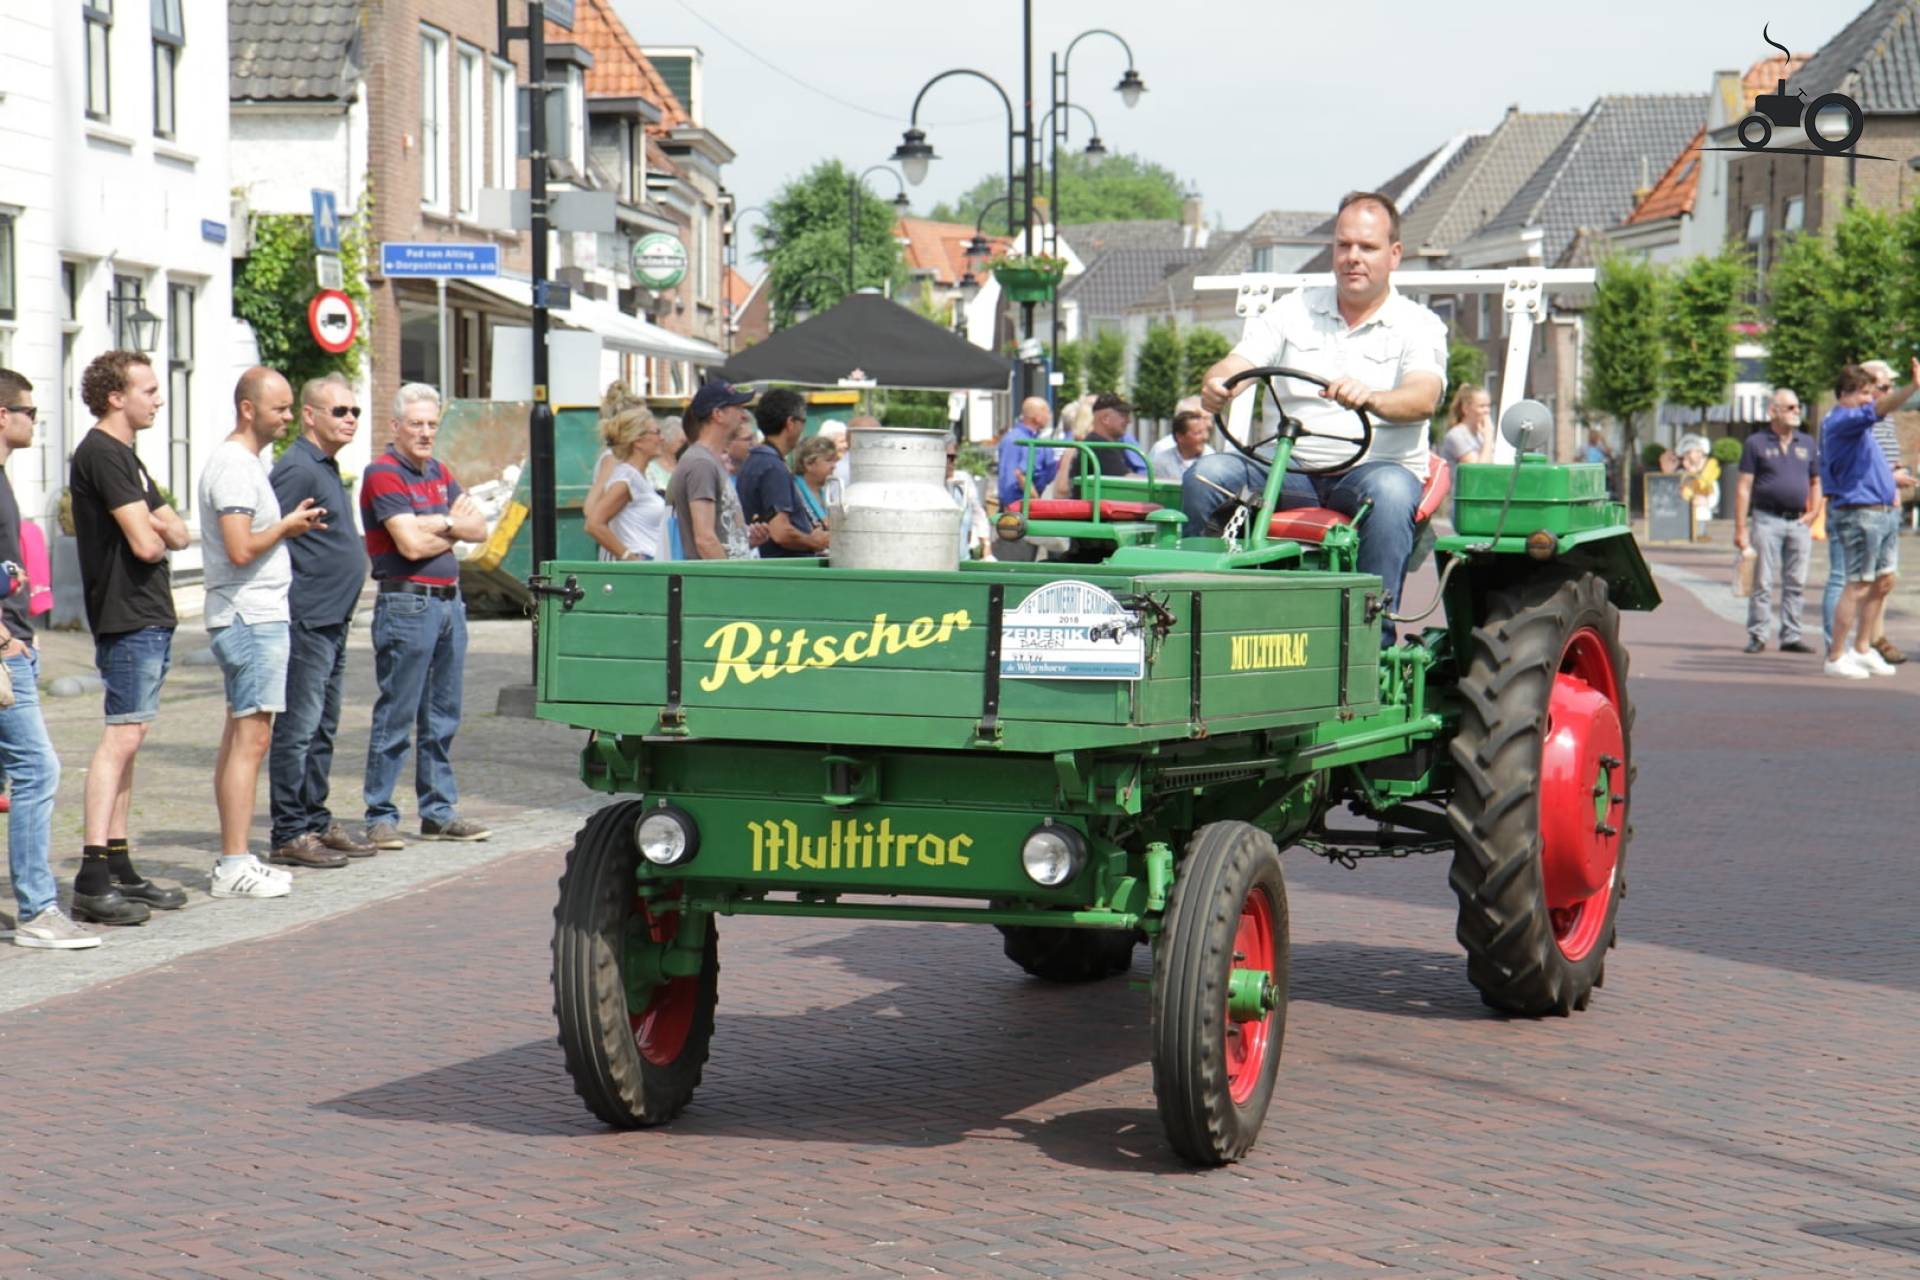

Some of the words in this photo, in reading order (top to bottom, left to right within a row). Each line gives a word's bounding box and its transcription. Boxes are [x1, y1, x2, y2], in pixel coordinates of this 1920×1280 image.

[405, 247, 424, 258] Pad
[426, 250, 443, 258] van
[395, 260, 453, 271] Dorpsstraat
[1001, 628, 1085, 640] ZEDERIK
[1020, 639, 1065, 649] DAGEN
[700, 609, 972, 692] Ritscher
[1230, 632, 1309, 671] MULTITRAC
[747, 817, 975, 872] Multitrac
